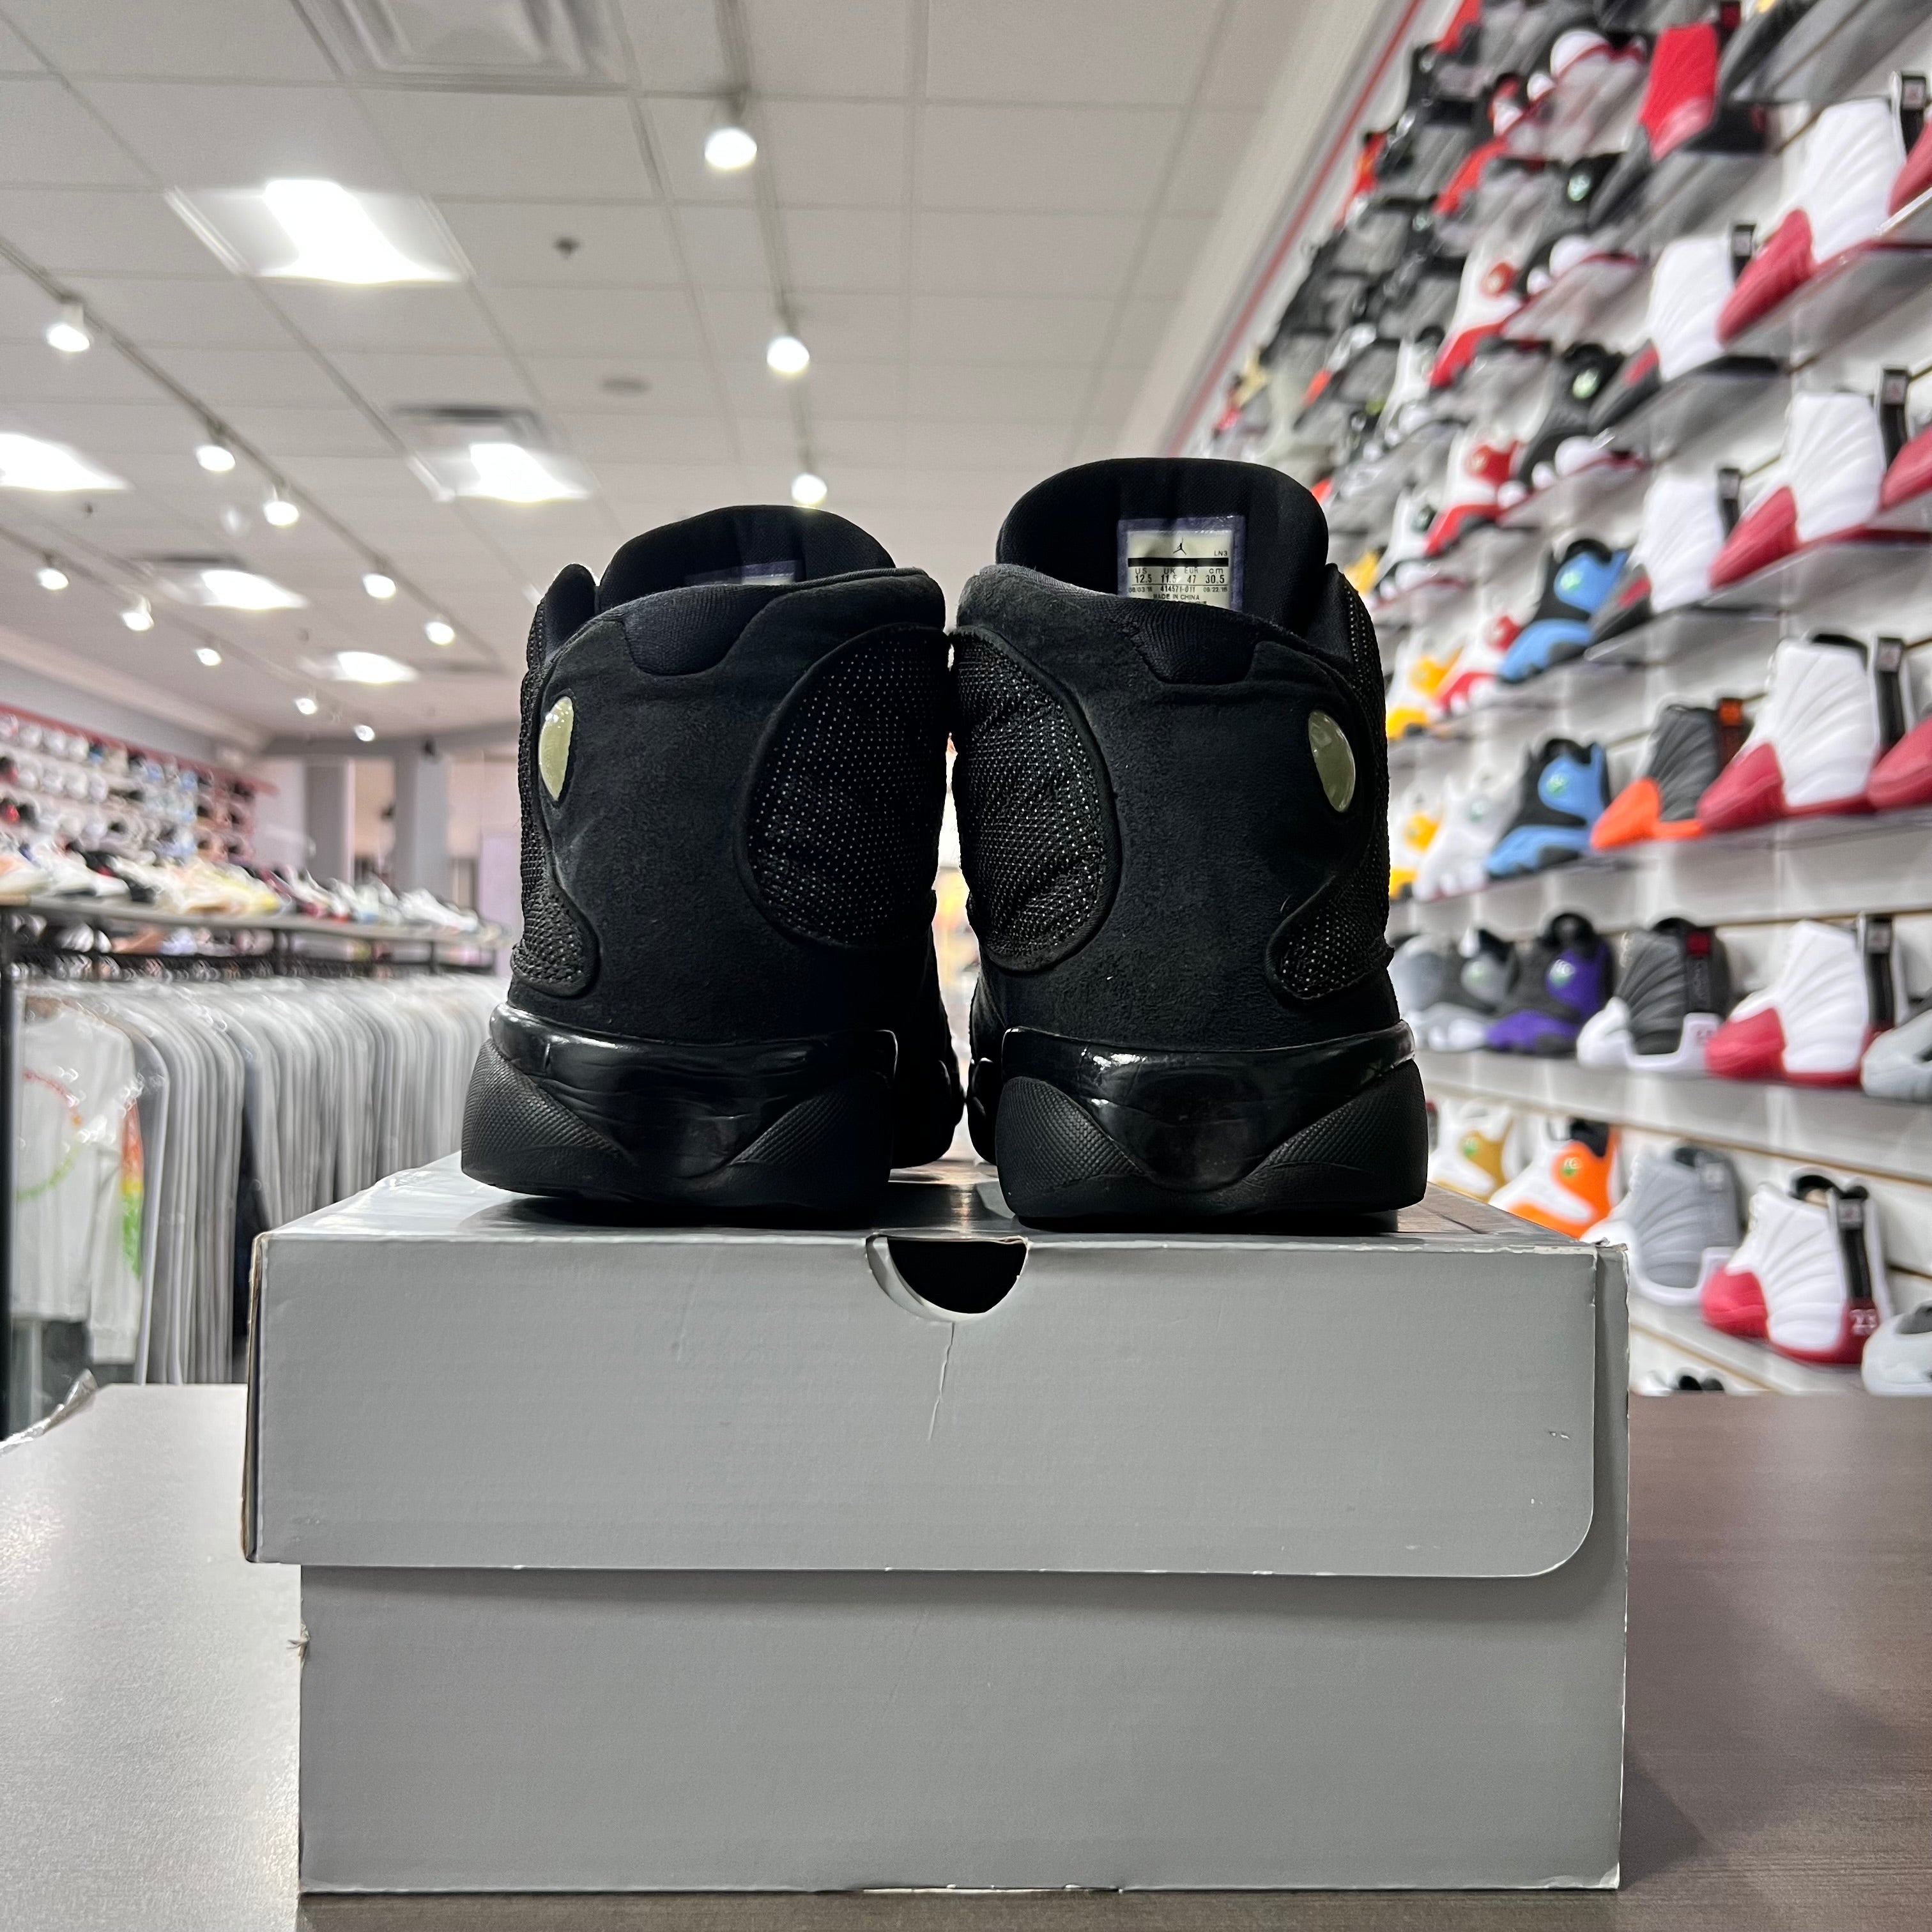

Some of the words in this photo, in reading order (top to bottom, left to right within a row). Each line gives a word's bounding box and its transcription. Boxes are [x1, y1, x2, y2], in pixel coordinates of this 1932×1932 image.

[1135, 574, 1152, 583] 12.5
[1161, 574, 1177, 583] 11.5
[1187, 574, 1196, 583] 47
[1205, 574, 1225, 583] 30.5
